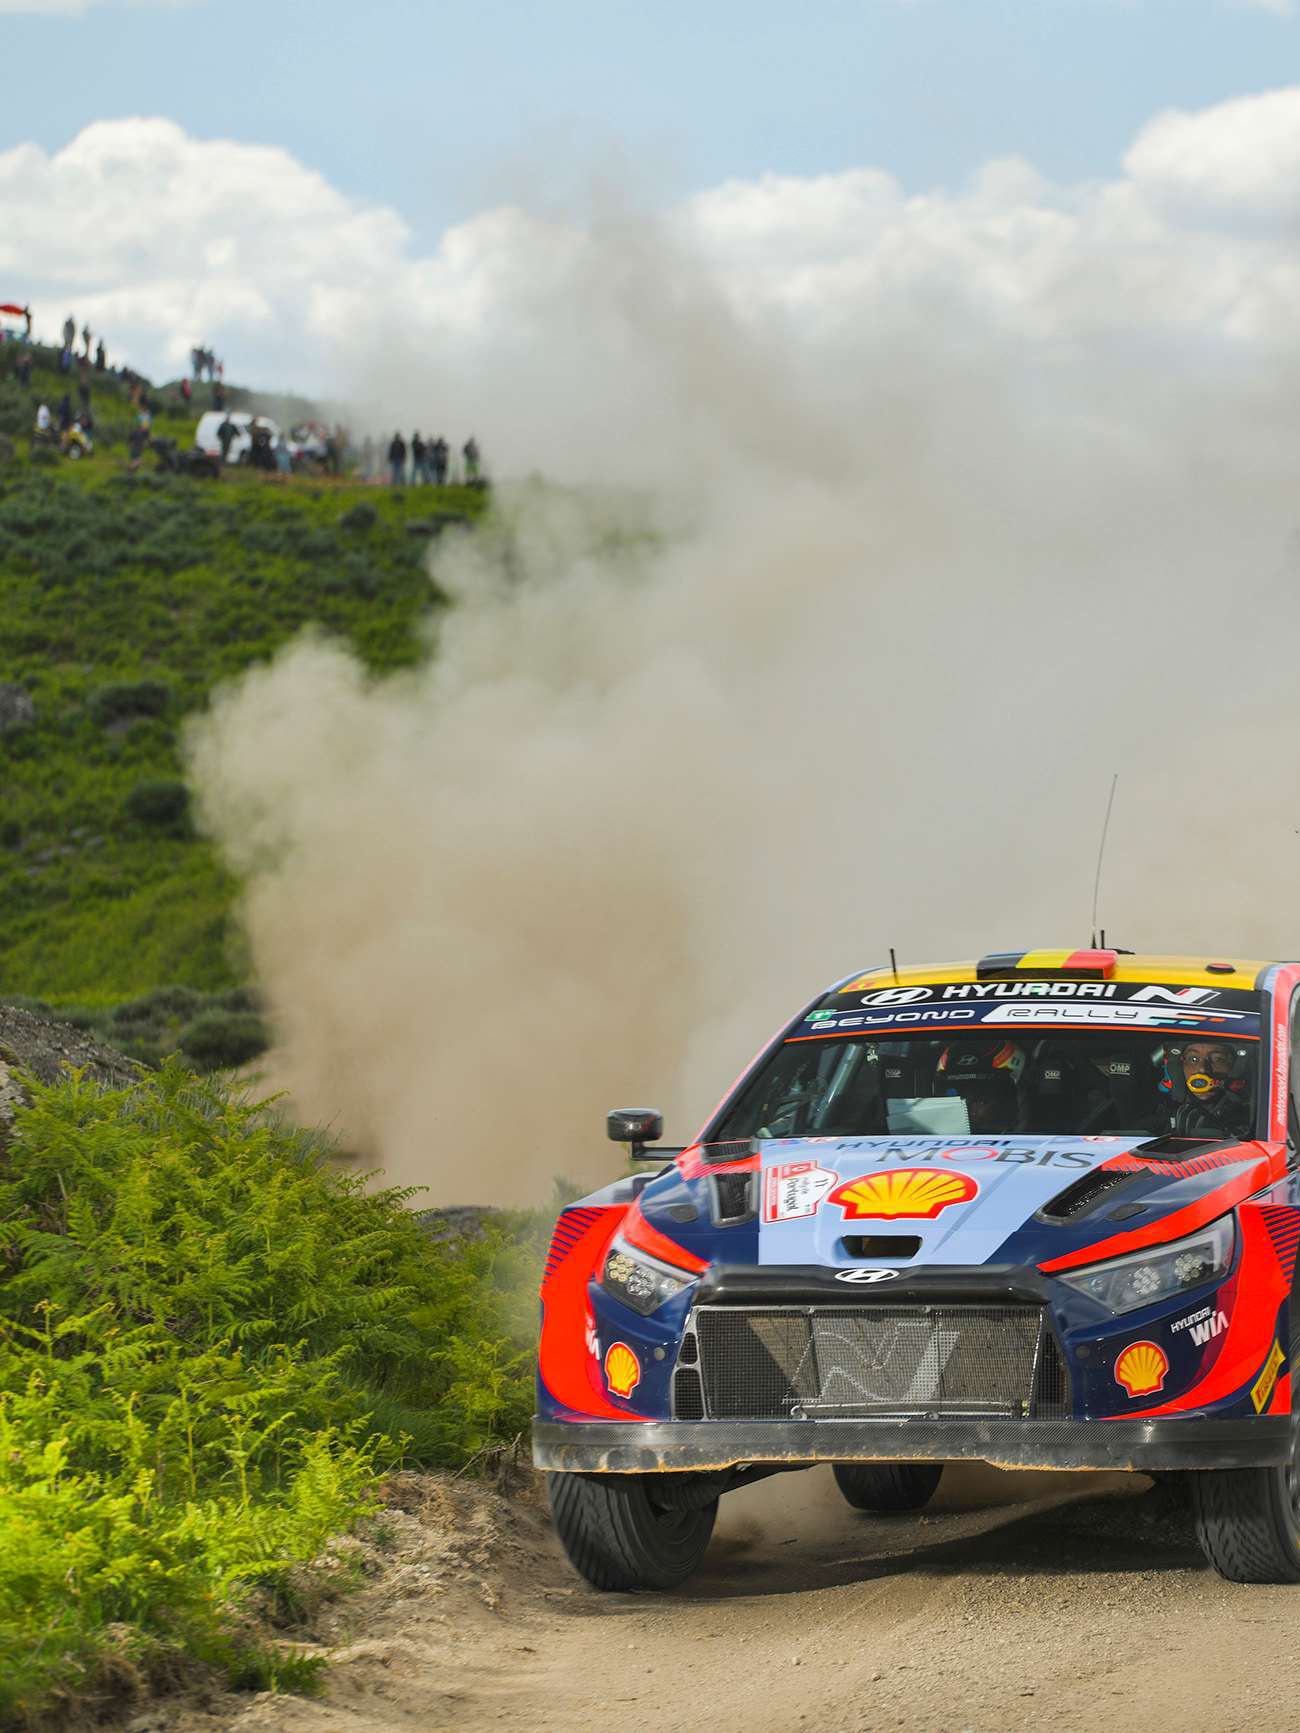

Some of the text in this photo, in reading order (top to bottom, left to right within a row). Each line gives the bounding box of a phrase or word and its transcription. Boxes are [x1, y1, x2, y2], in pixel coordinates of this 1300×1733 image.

[942, 983, 1117, 999] HYUNDAI
[811, 1008, 1139, 1030] BEYOND RALLY
[835, 1140, 1012, 1150] HYUNDAI
[875, 1146, 1095, 1168] MOBIS
[1170, 1306, 1211, 1333] HYUNDAI
